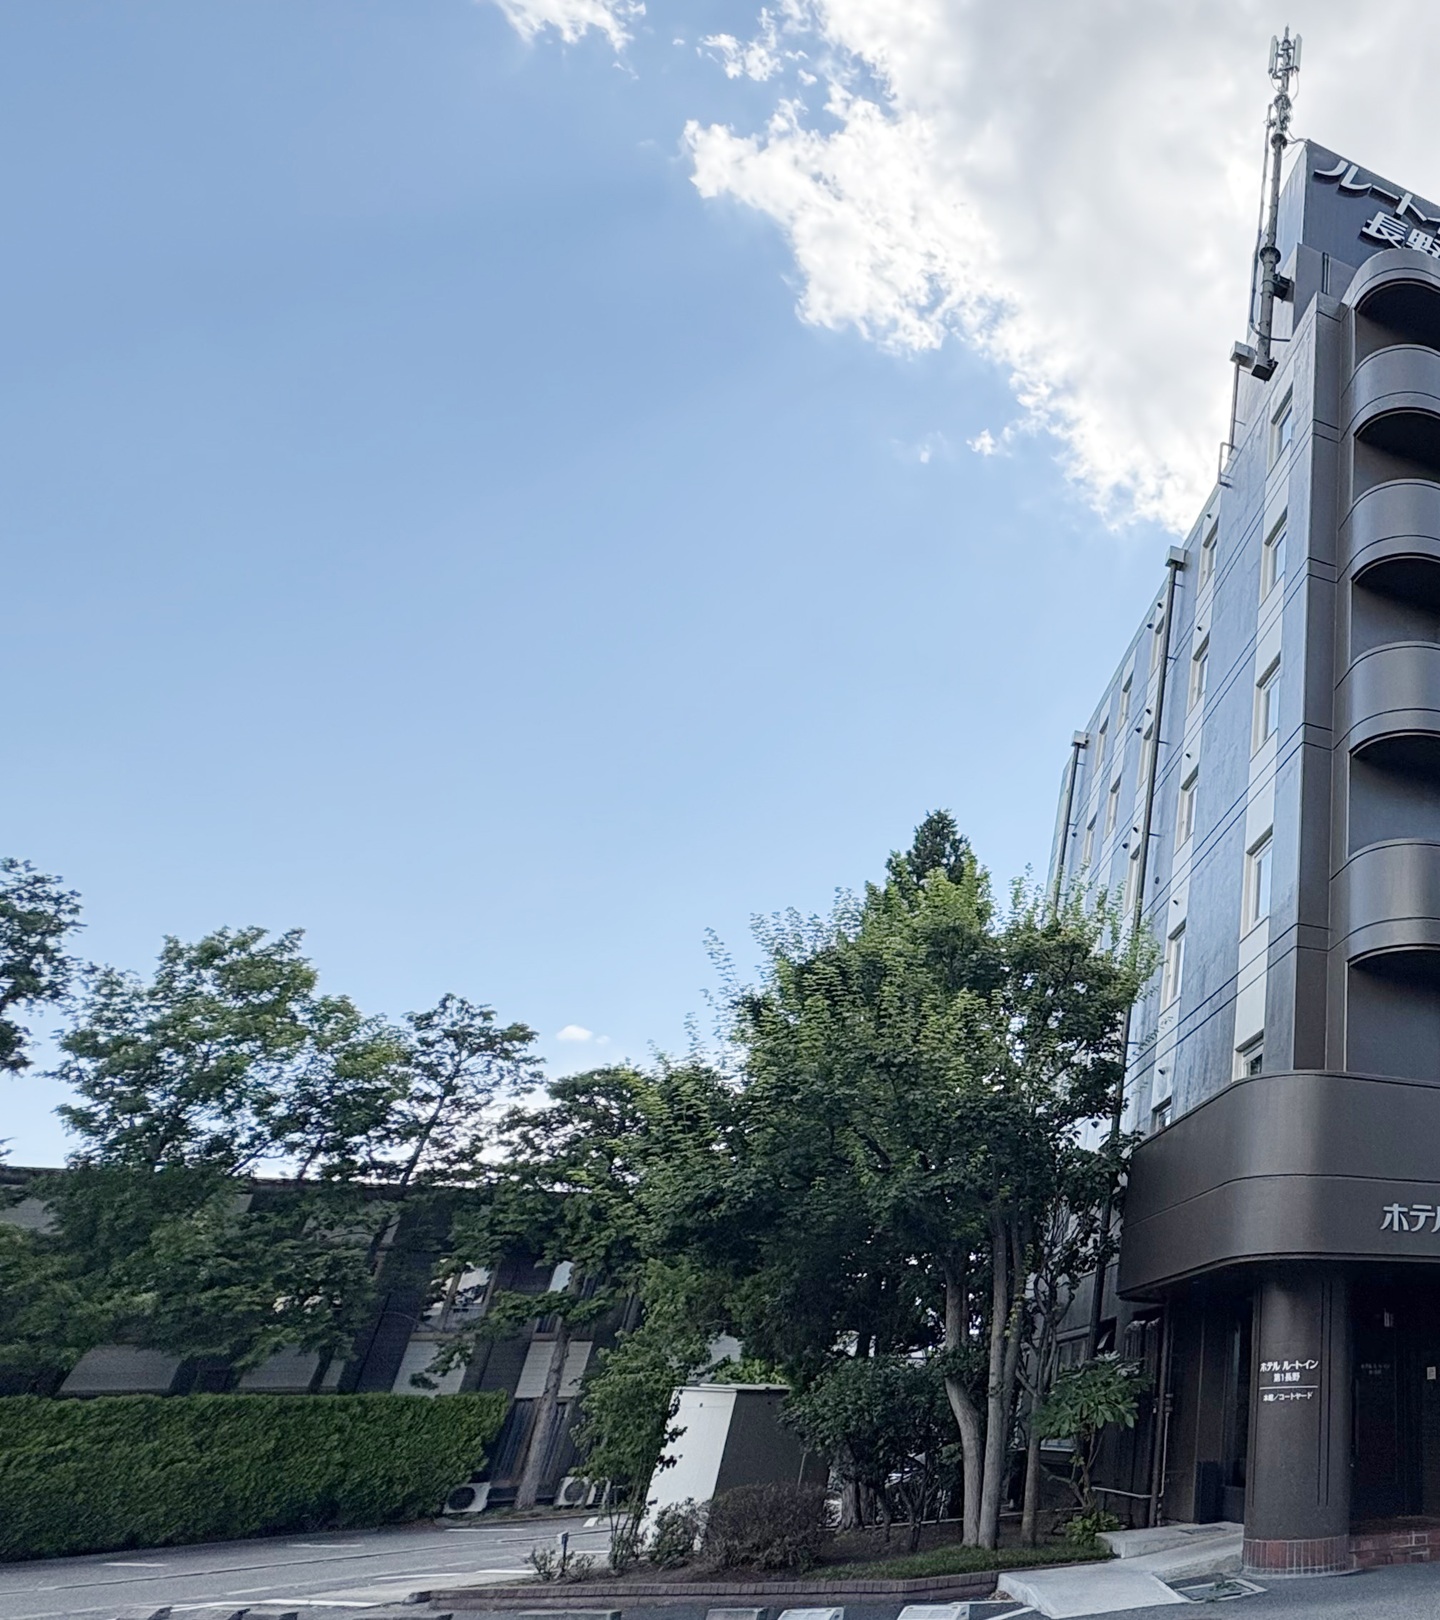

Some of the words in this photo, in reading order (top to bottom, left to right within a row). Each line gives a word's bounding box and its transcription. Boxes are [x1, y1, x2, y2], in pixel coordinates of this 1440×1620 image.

[1260, 1361, 1280, 1372] ホテル
[1282, 1360, 1319, 1370] ルートイン
